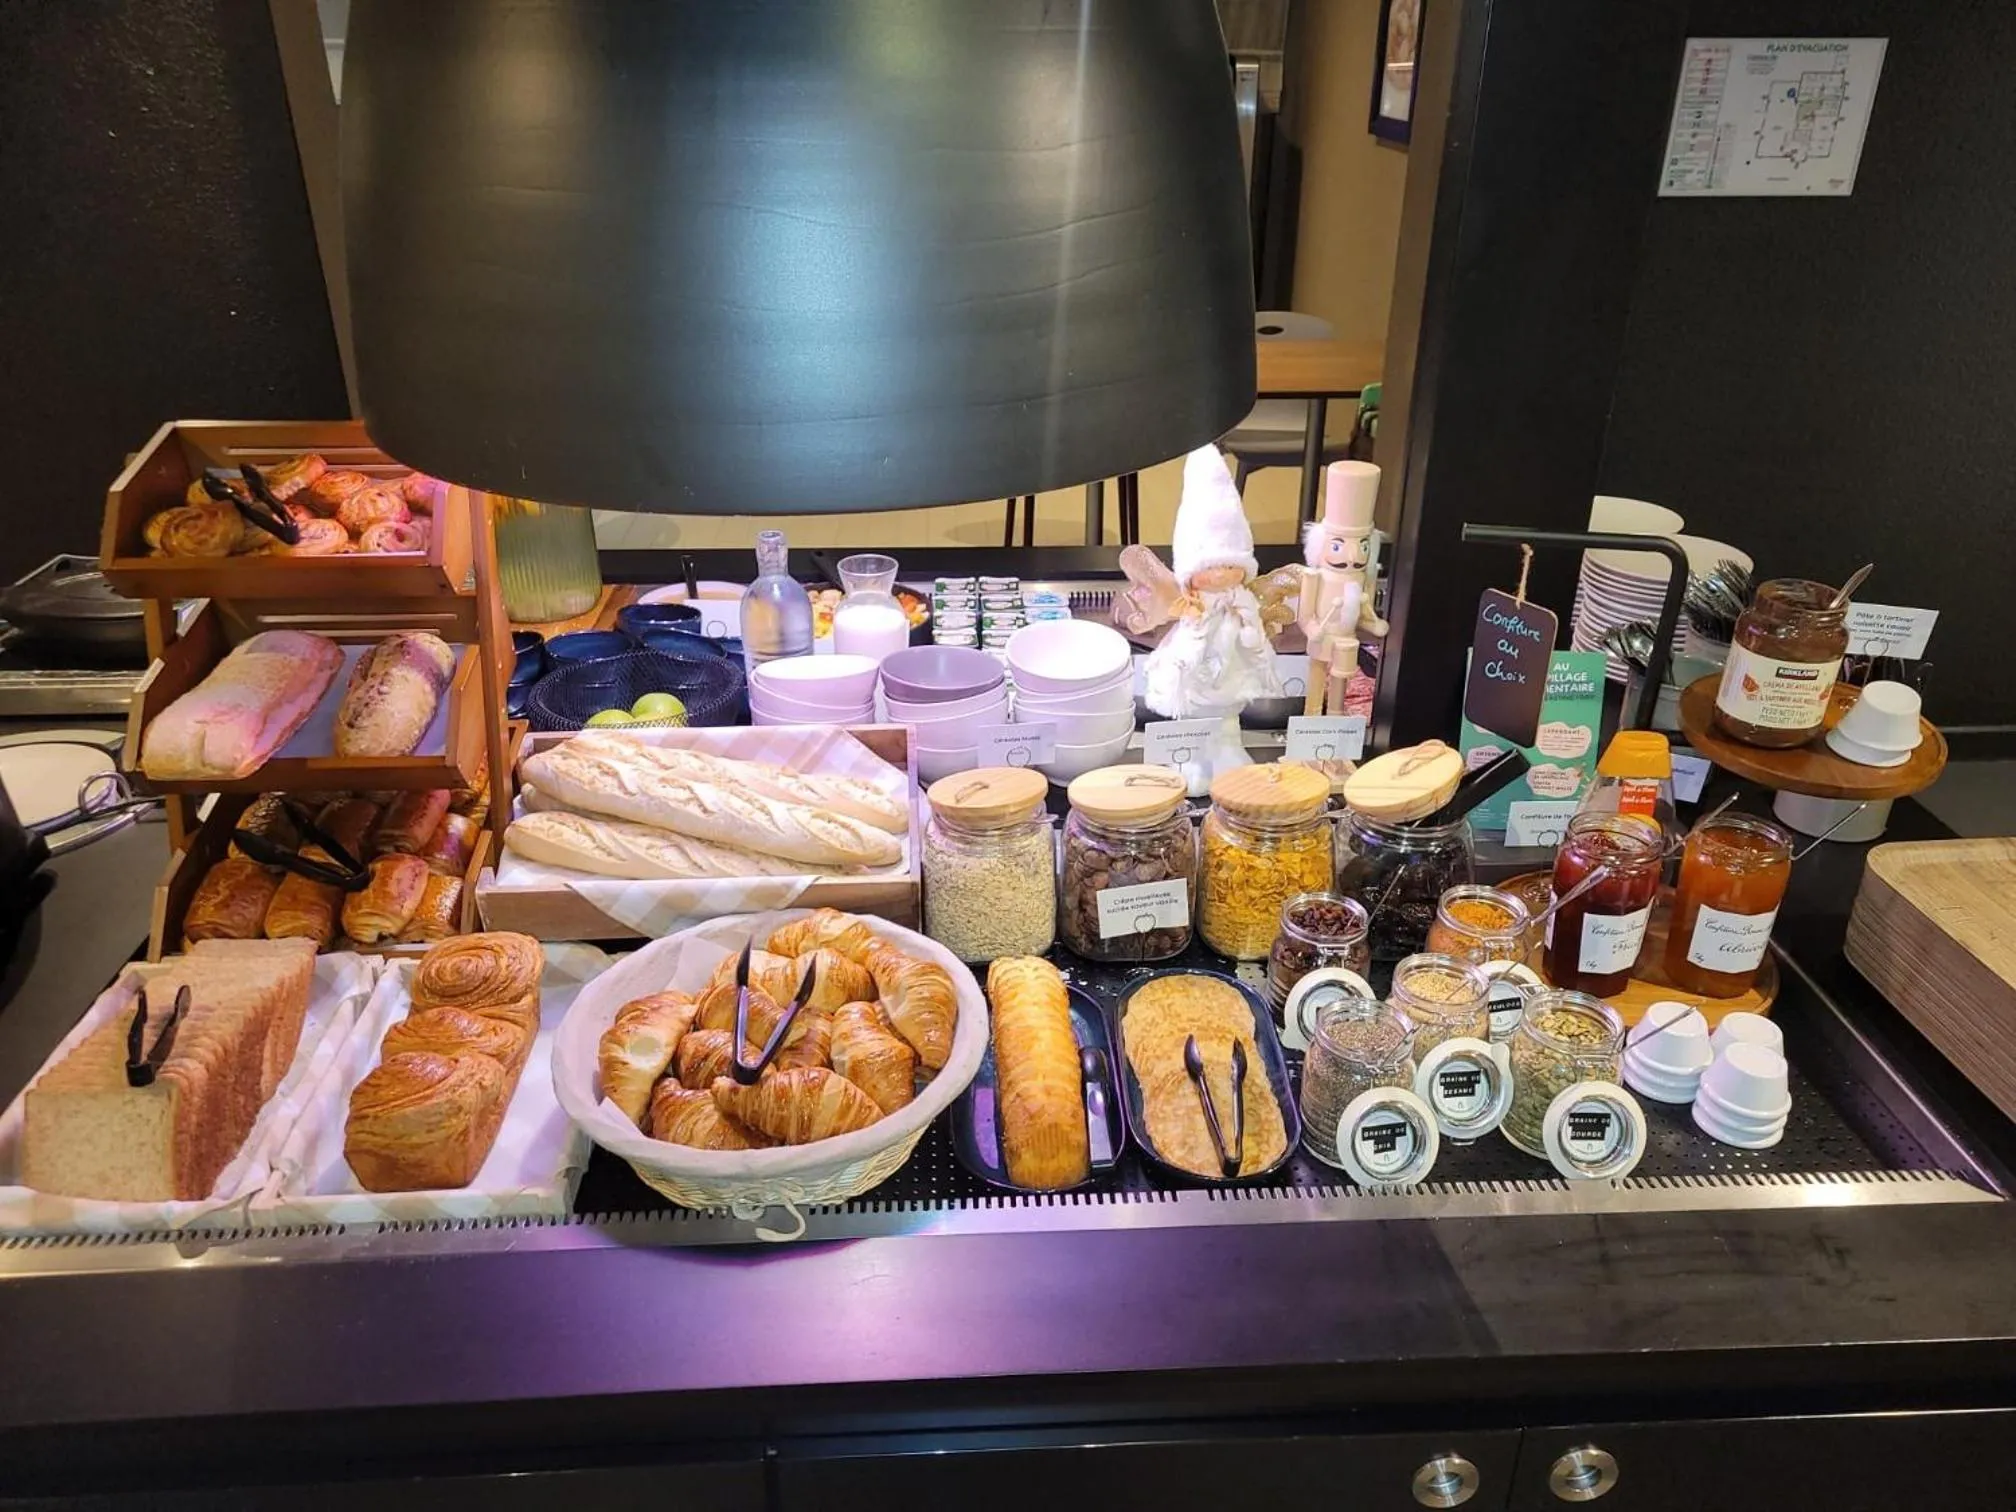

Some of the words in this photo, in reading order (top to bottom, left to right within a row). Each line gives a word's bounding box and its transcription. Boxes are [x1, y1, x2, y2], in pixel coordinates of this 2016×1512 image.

[1482, 603, 1541, 642] Confiture
[1496, 639, 1520, 660] au
[1484, 660, 1527, 685] Choix
[1553, 662, 1570, 671] AU
